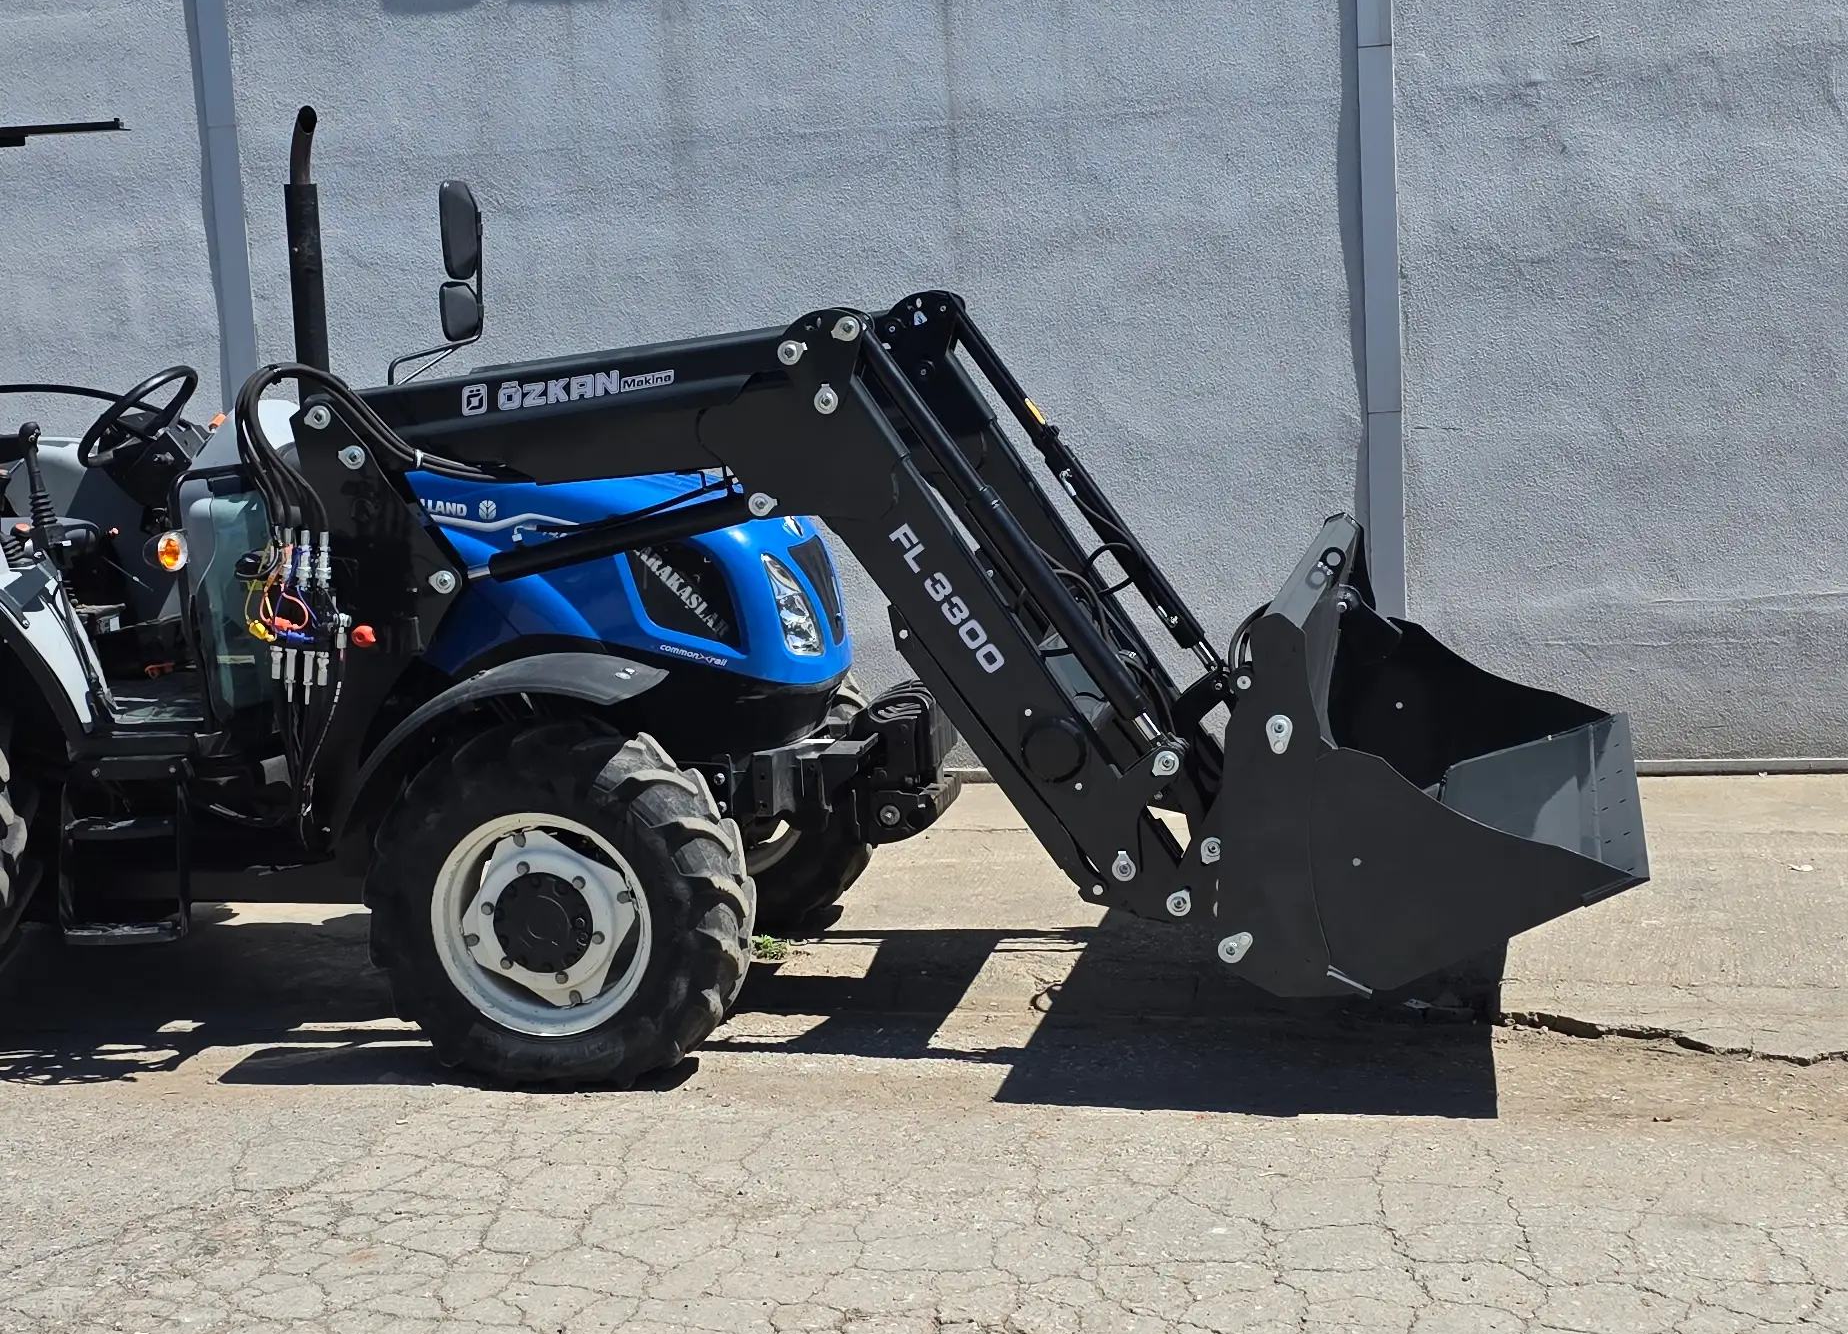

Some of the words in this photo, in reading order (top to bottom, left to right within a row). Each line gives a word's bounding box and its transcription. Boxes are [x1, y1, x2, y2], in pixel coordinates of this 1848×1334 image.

[498, 370, 620, 411] ÖZKAN
[623, 374, 672, 390] Makina
[888, 522, 925, 574] FL
[923, 571, 1005, 674] 3300
